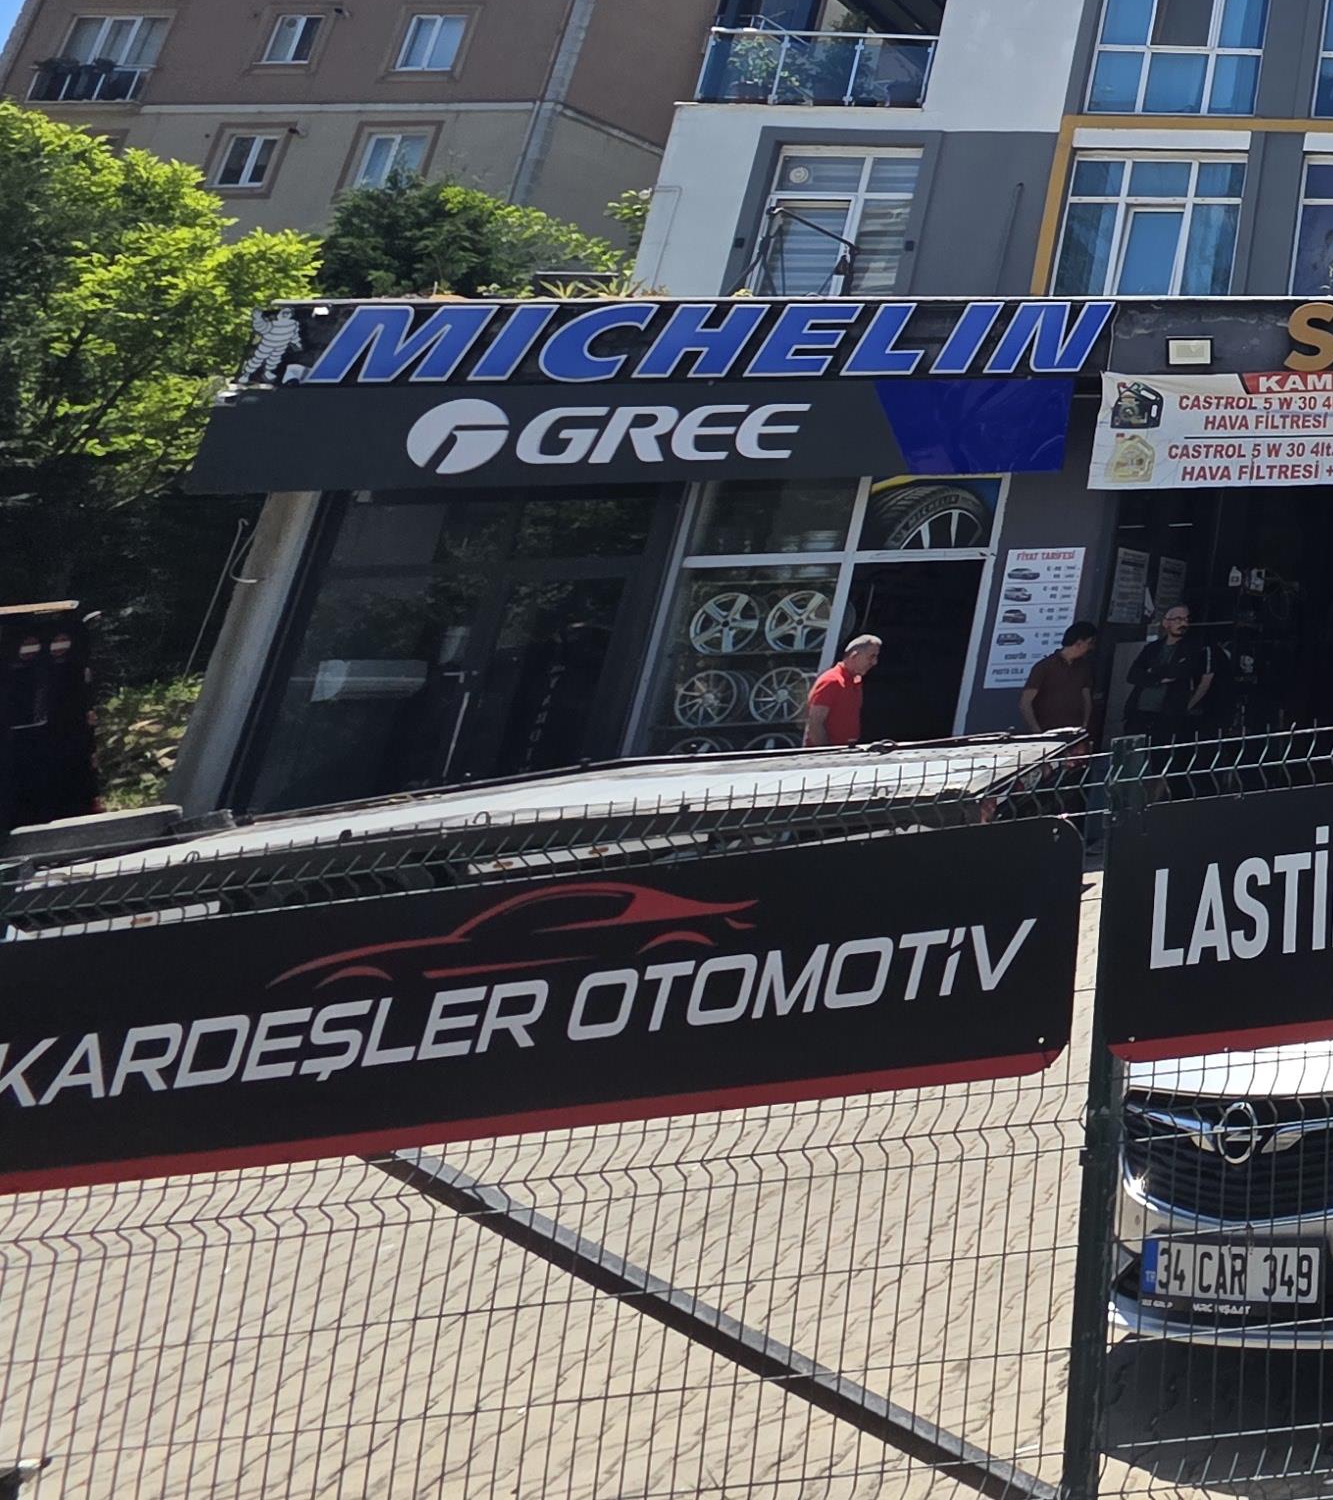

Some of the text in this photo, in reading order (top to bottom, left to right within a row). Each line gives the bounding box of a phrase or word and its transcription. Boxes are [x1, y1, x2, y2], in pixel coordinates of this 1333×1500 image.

[303, 301, 1116, 384] MICHELIN
[1178, 395, 1258, 411] CASTROL
[1263, 397, 1273, 411] 5
[1278, 397, 1293, 410] W
[1298, 396, 1317, 411] 30
[1204, 415, 1250, 431] HAVA
[1254, 411, 1328, 430] FİLTRESİ
[516, 404, 811, 465] GREE
[1168, 443, 1247, 460] CASTROL
[1251, 444, 1261, 458] 5
[1266, 443, 1282, 458] W
[1286, 442, 1306, 458] 30
[1181, 465, 1232, 482] HAVA
[1237, 460, 1320, 481] FİLTRESİ
[0, 918, 1037, 1107] KARDEŞLER OTOMOTİV
[1157, 1247, 1314, 1298] 34 CAR 349
